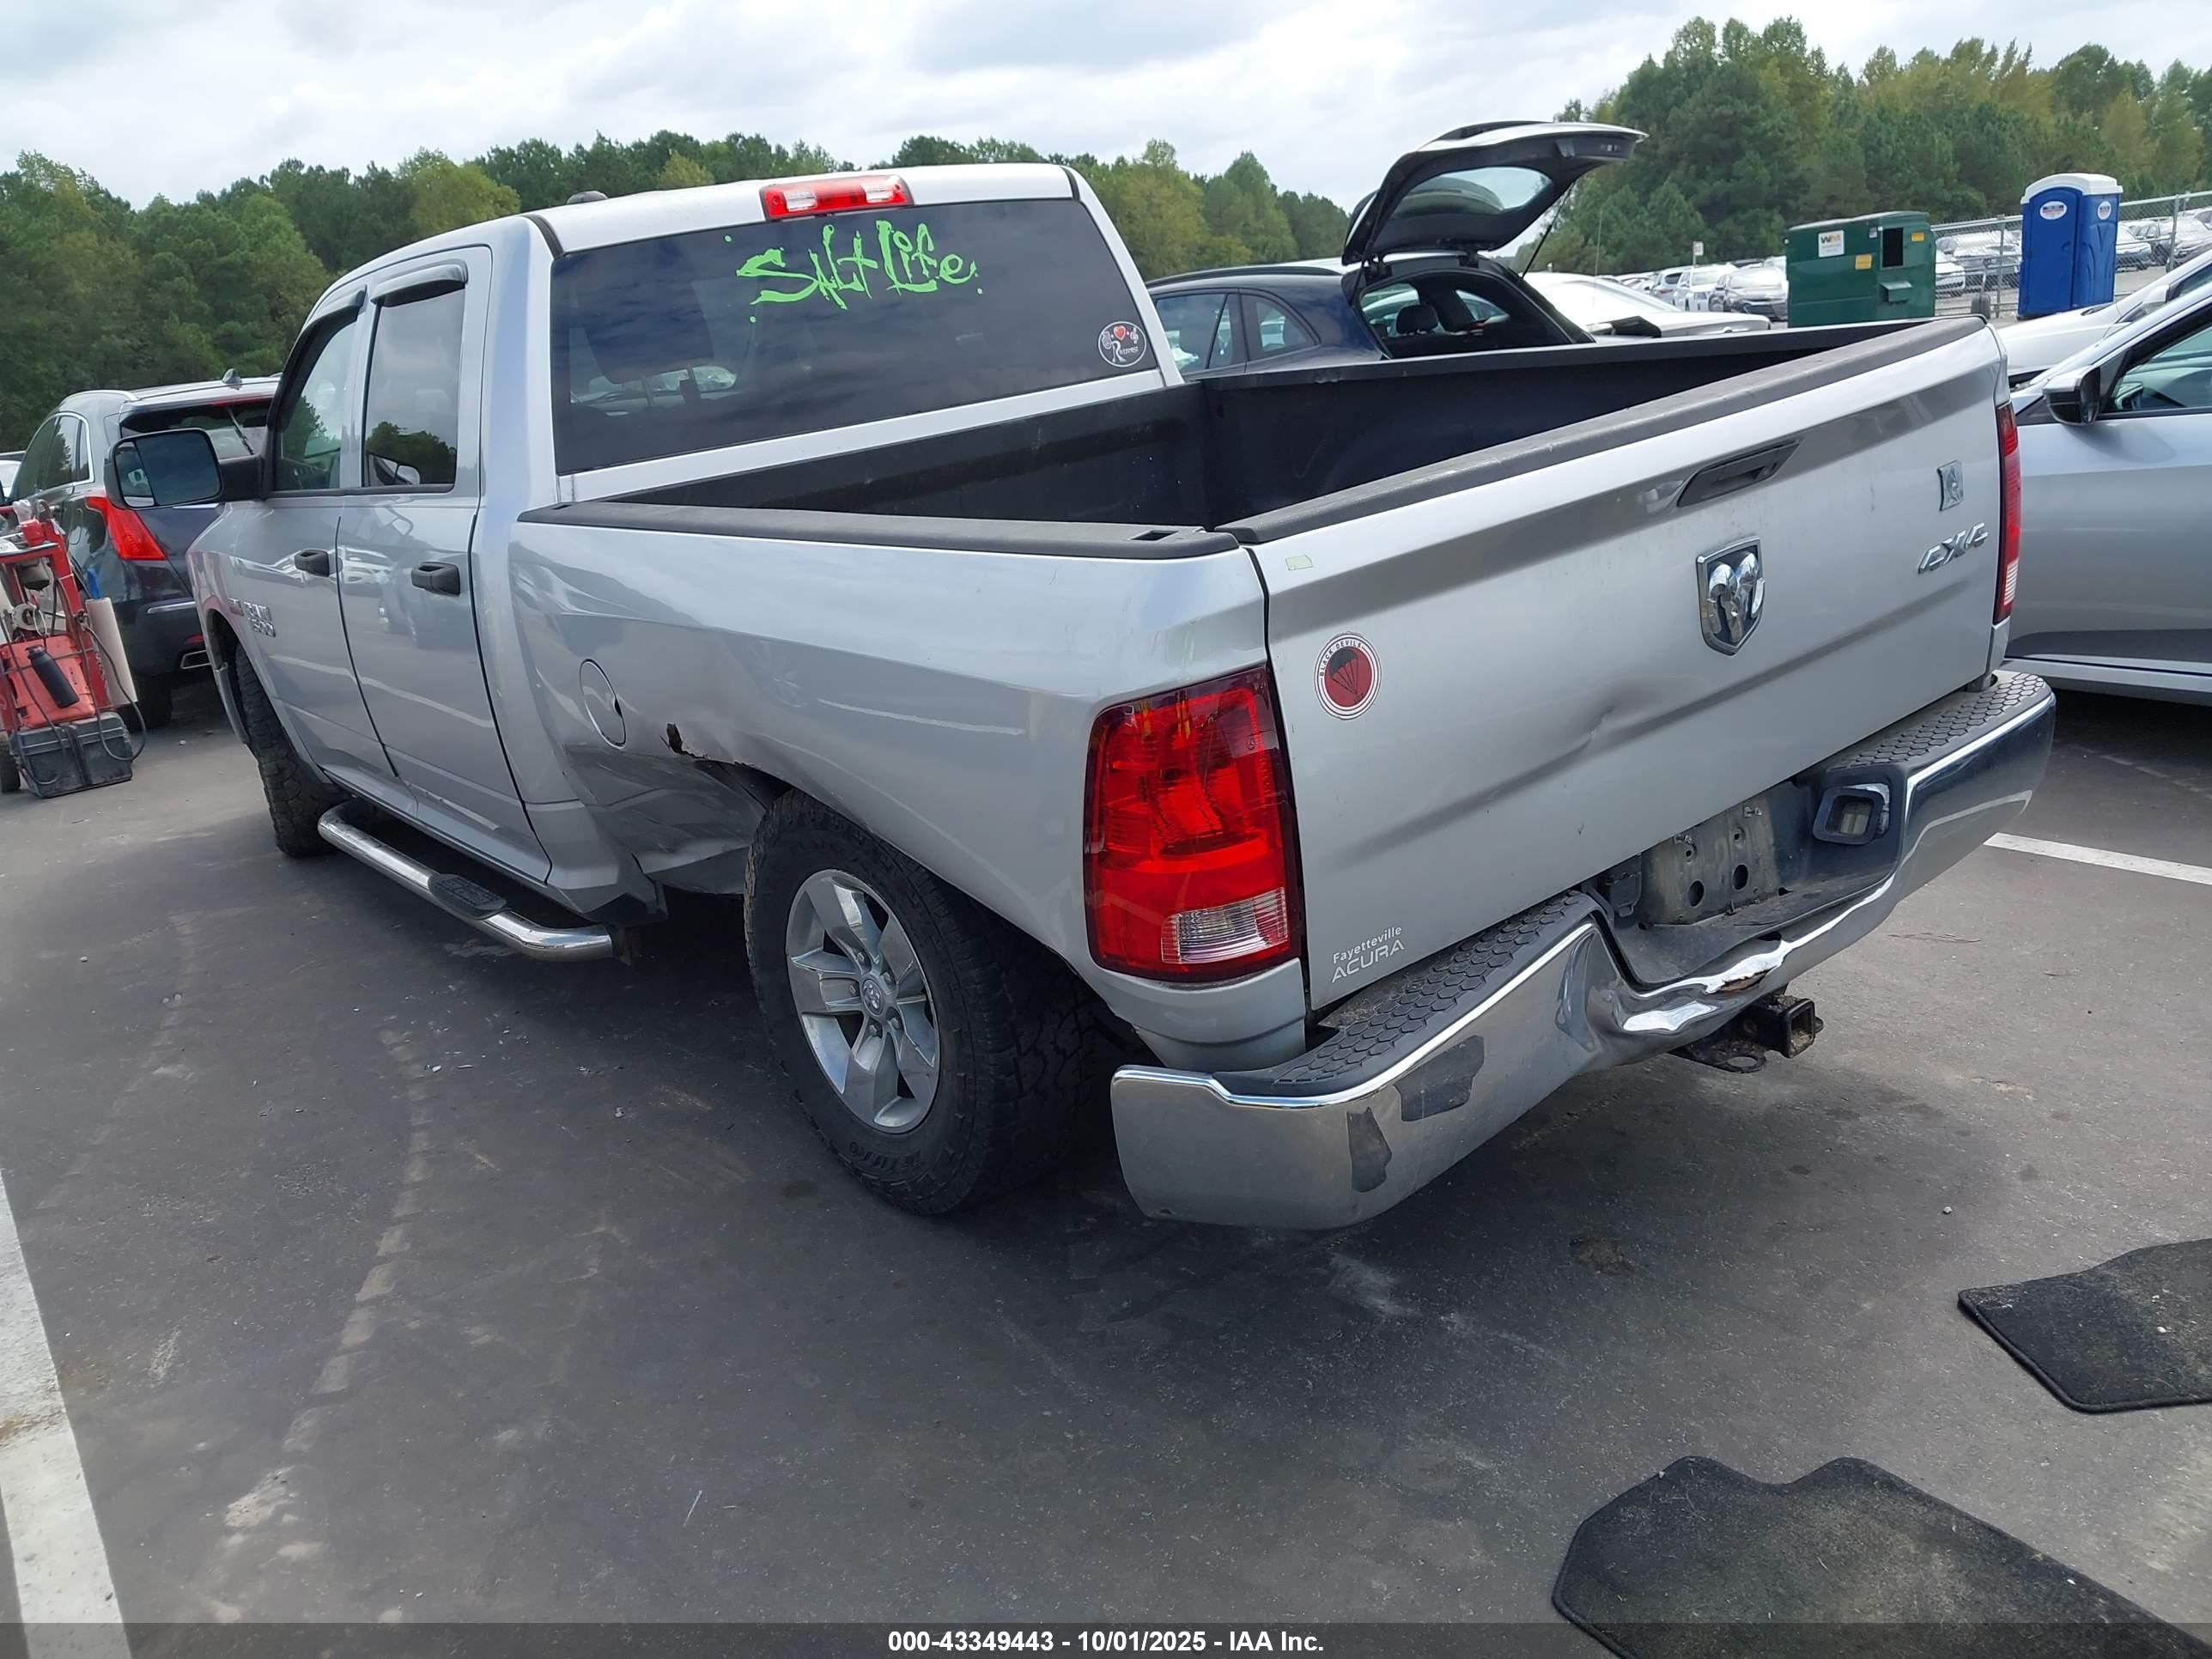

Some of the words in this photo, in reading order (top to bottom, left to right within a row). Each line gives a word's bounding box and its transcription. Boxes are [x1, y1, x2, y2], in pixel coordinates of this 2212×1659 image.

[1319, 649, 1334, 677] BLACK
[1335, 640, 1362, 649] DEVILS
[1332, 939, 1405, 983] ACURA
[1333, 927, 1402, 964] Fayetteville
